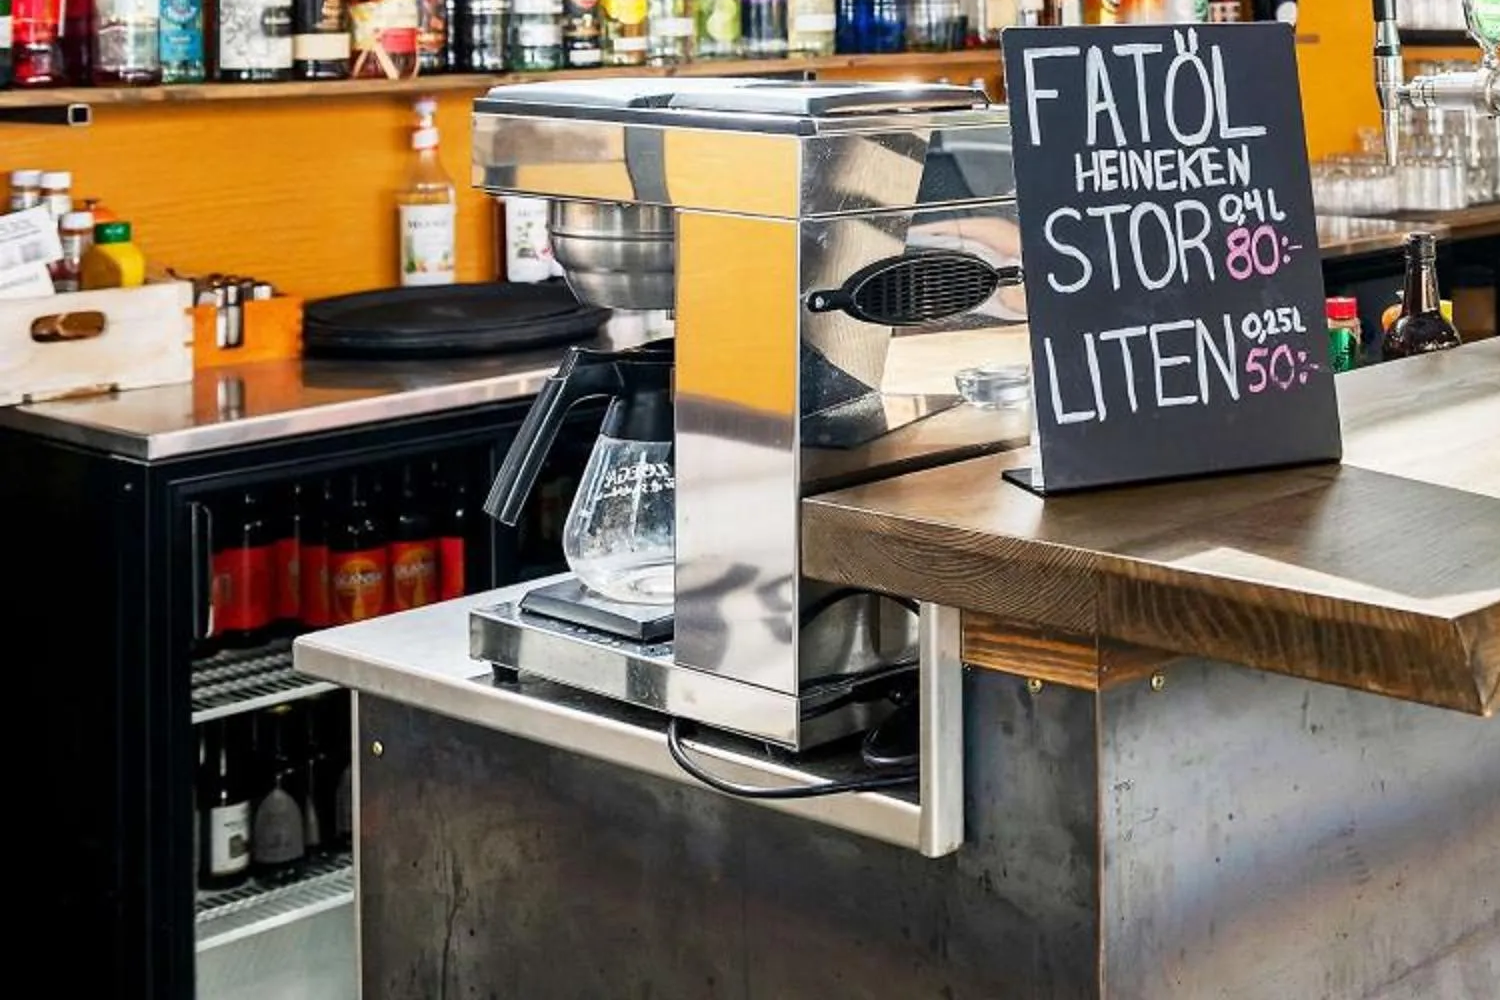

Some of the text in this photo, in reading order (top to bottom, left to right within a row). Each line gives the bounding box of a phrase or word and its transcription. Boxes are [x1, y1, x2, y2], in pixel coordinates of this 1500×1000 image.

[1024, 27, 1267, 146] FATÖL
[1075, 144, 1250, 193] HEINEKEN
[1044, 200, 1215, 292] STOR
[1045, 313, 1241, 425] LITEN
